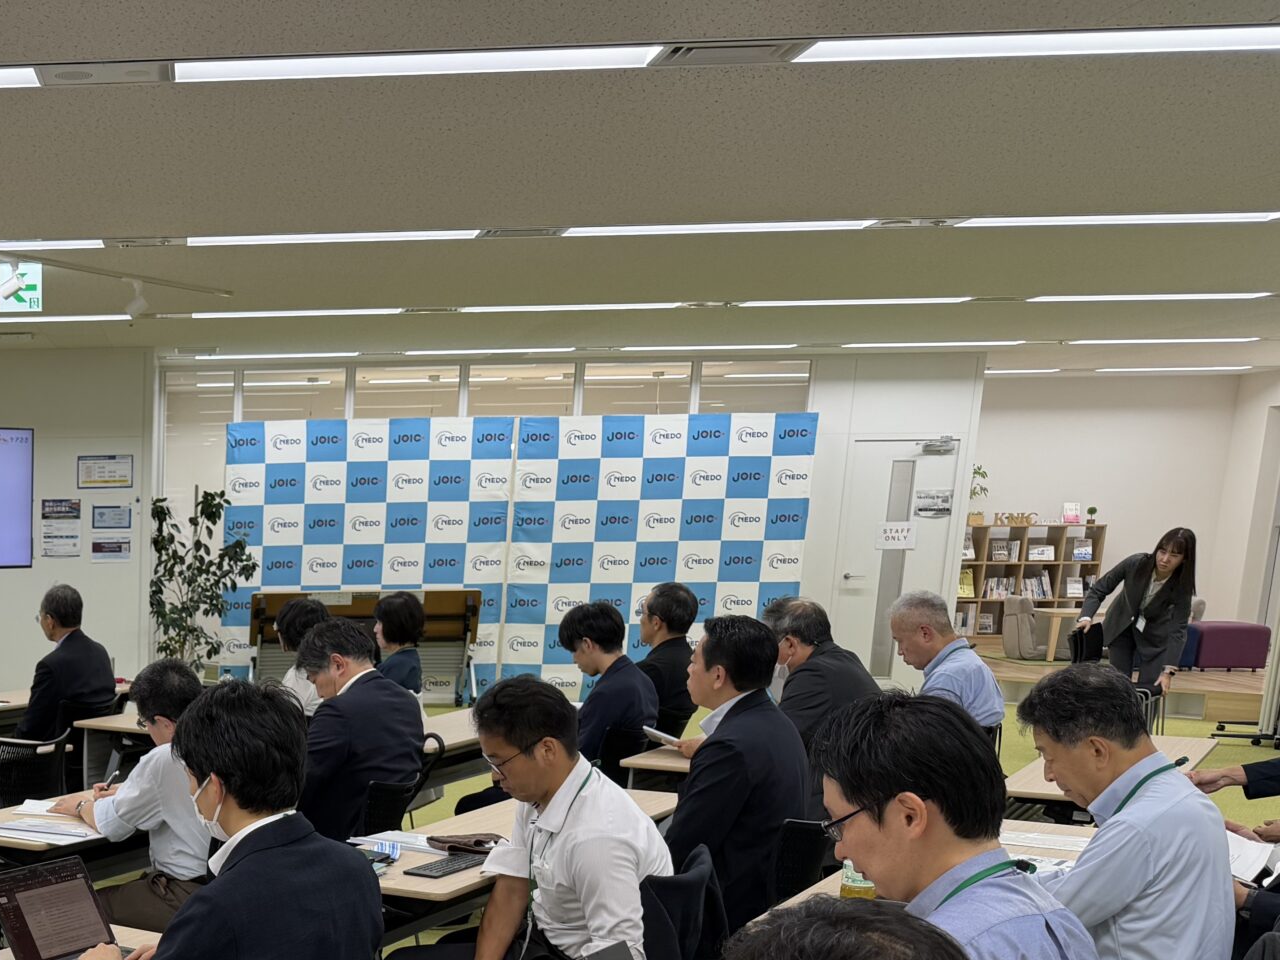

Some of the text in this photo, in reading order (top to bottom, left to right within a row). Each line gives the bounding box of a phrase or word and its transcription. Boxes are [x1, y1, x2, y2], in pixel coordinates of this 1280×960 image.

[477, 432, 505, 442] JOIC
[522, 433, 550, 442] JOIC
[574, 433, 597, 441] NEDO
[606, 432, 635, 441] JOIC
[659, 432, 682, 440] NEDO
[692, 430, 721, 440] JOIC
[746, 431, 768, 439] NEDO
[778, 429, 808, 439] JOIC
[230, 438, 257, 448] JOIC
[280, 438, 301, 446] NEDO
[311, 435, 339, 446] JOIC
[363, 436, 384, 444] NEDO
[393, 434, 422, 444] JOIC
[445, 435, 467, 443] NEDO
[402, 477, 424, 485] NEDO
[433, 476, 461, 486] JOIC
[561, 475, 590, 484] JOIC
[614, 475, 637, 483] NEDO
[647, 473, 676, 483] JOIC
[699, 474, 722, 482] NEDO
[732, 473, 761, 482] JOIC
[785, 473, 808, 481] NEDO
[239, 481, 260, 489] NEDO
[270, 478, 297, 489] JOIC
[320, 479, 341, 487] NEDO
[351, 477, 379, 487] JOIC
[308, 519, 336, 529] JOIC
[390, 518, 418, 528] JOIC
[473, 517, 502, 527] JOIC
[516, 517, 545, 526] JOIC
[600, 516, 630, 526] JOIC
[685, 515, 715, 525] JOIC
[738, 516, 761, 524] NEDO
[770, 515, 800, 524] JOIC
[228, 521, 255, 531] JOIC
[278, 521, 299, 529] NEDO
[316, 561, 338, 569] NEDO
[347, 559, 375, 569] JOIC
[397, 560, 419, 568] NEDO
[428, 558, 457, 568] JOIC
[479, 559, 502, 567] NEDO
[555, 558, 584, 568] JOIC
[640, 557, 669, 567] JOIC
[724, 556, 753, 566] JOIC
[266, 561, 293, 571] JOIC
[510, 598, 538, 608] JOIC
[729, 599, 752, 607] NEDO
